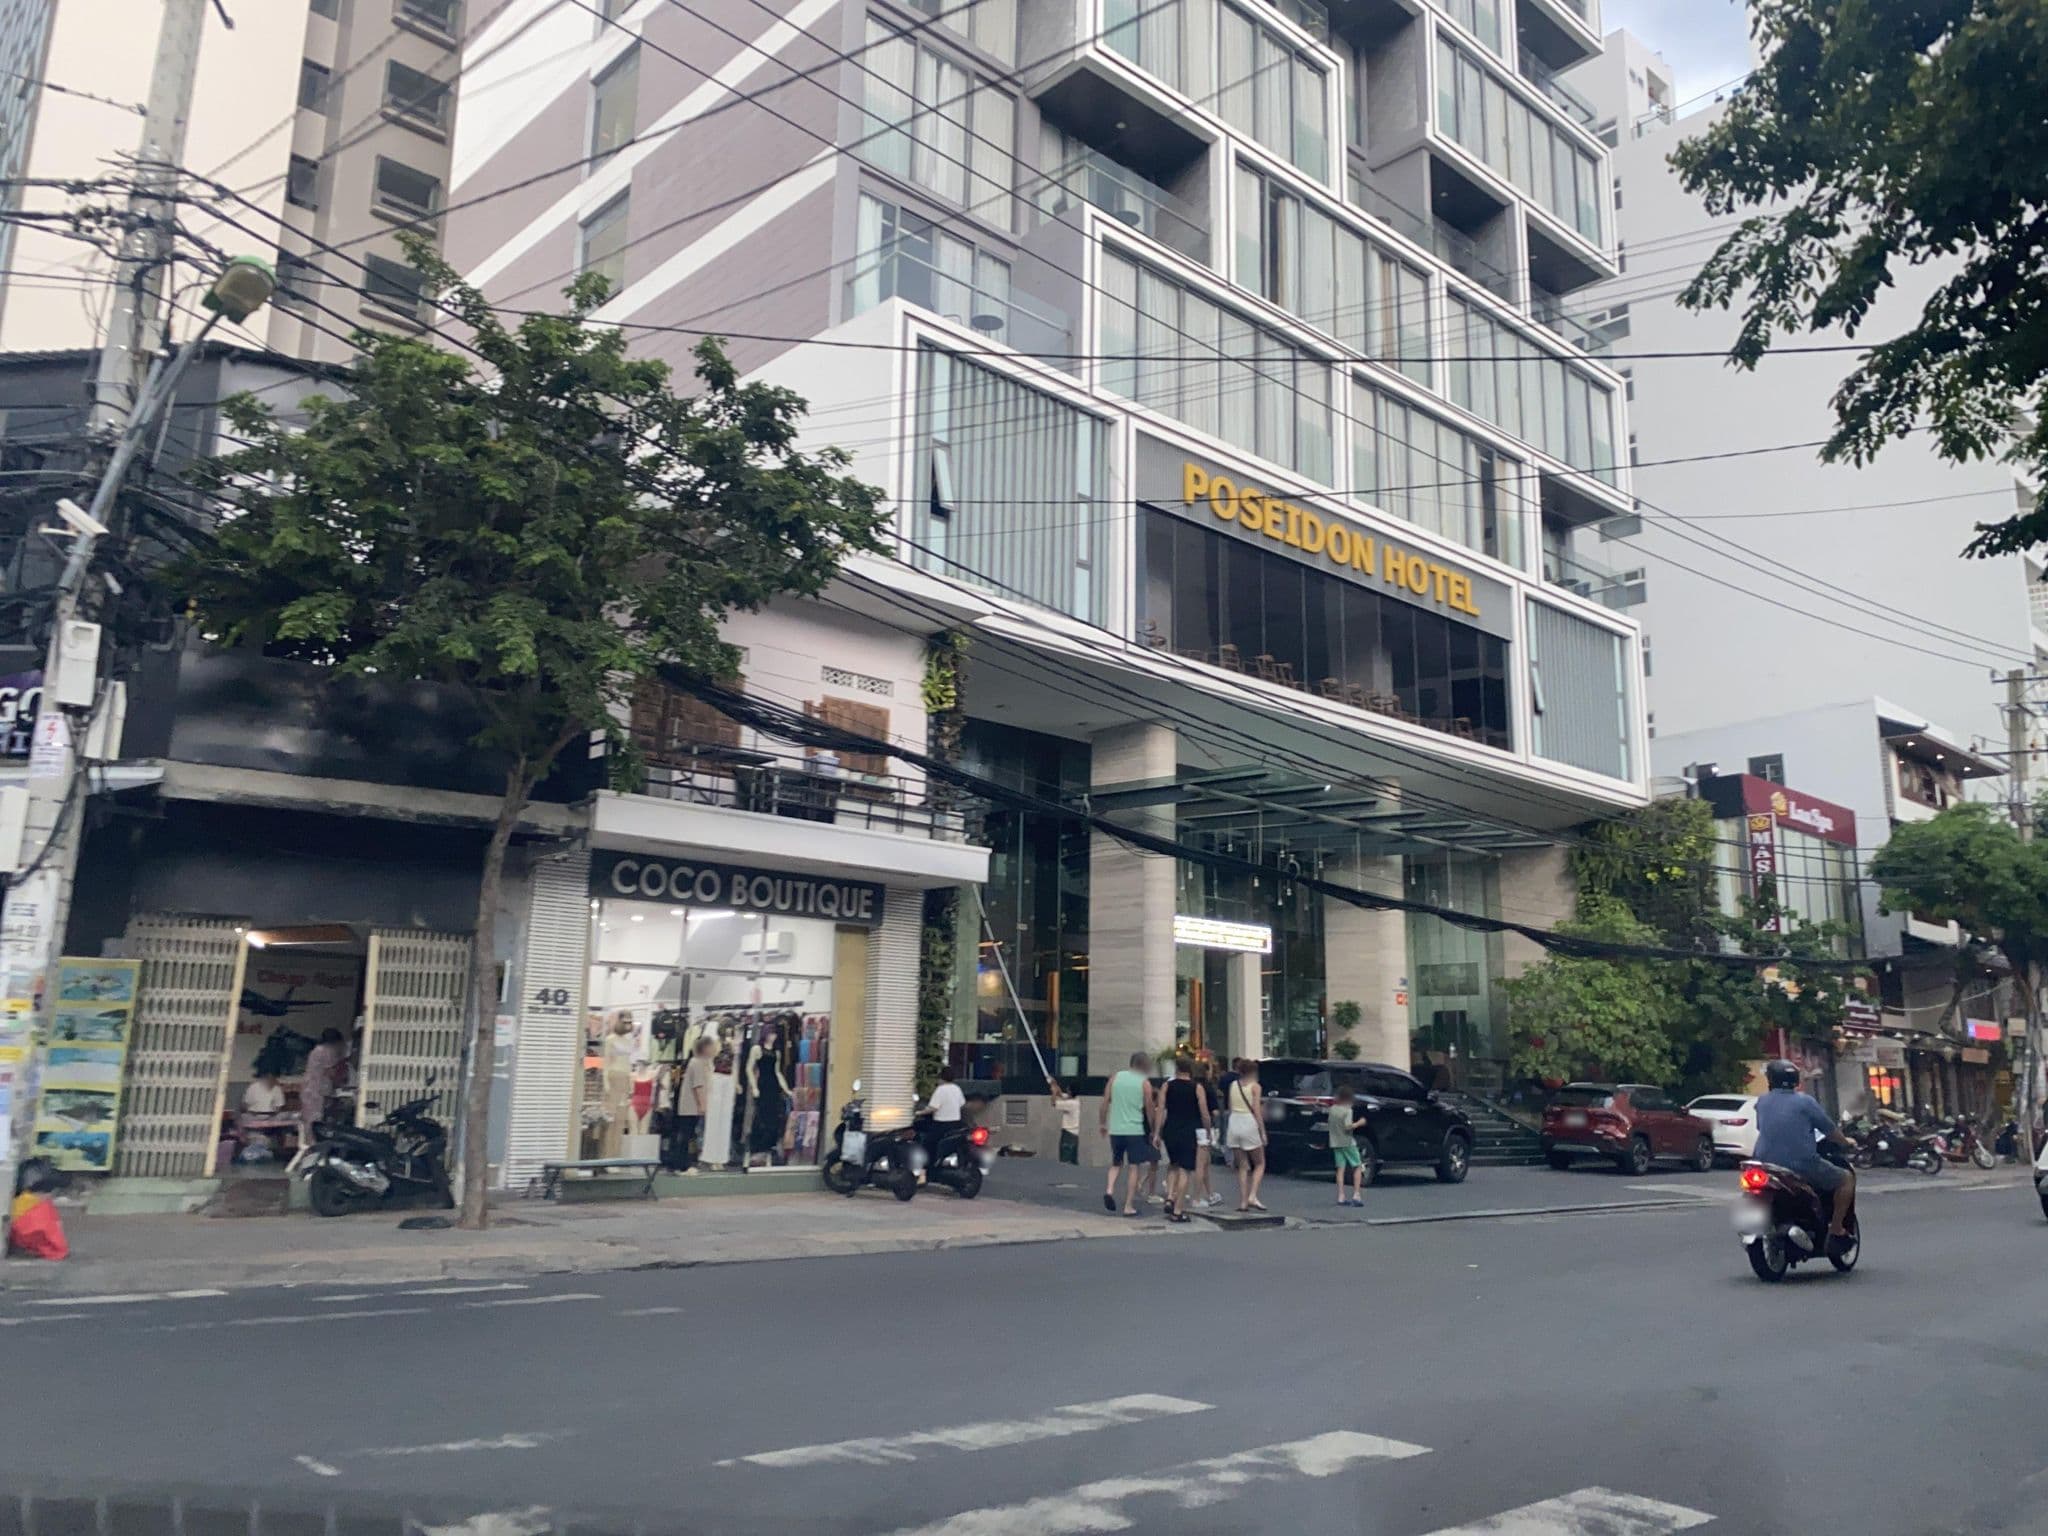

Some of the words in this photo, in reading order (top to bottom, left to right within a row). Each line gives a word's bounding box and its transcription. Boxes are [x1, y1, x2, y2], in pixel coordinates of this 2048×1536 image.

[1183, 462, 1375, 576] POSEIDON
[1384, 544, 1480, 617] HOTEL
[611, 859, 721, 902] COCO
[731, 874, 873, 919] BOUTIQUE
[535, 987, 569, 1006] 40
